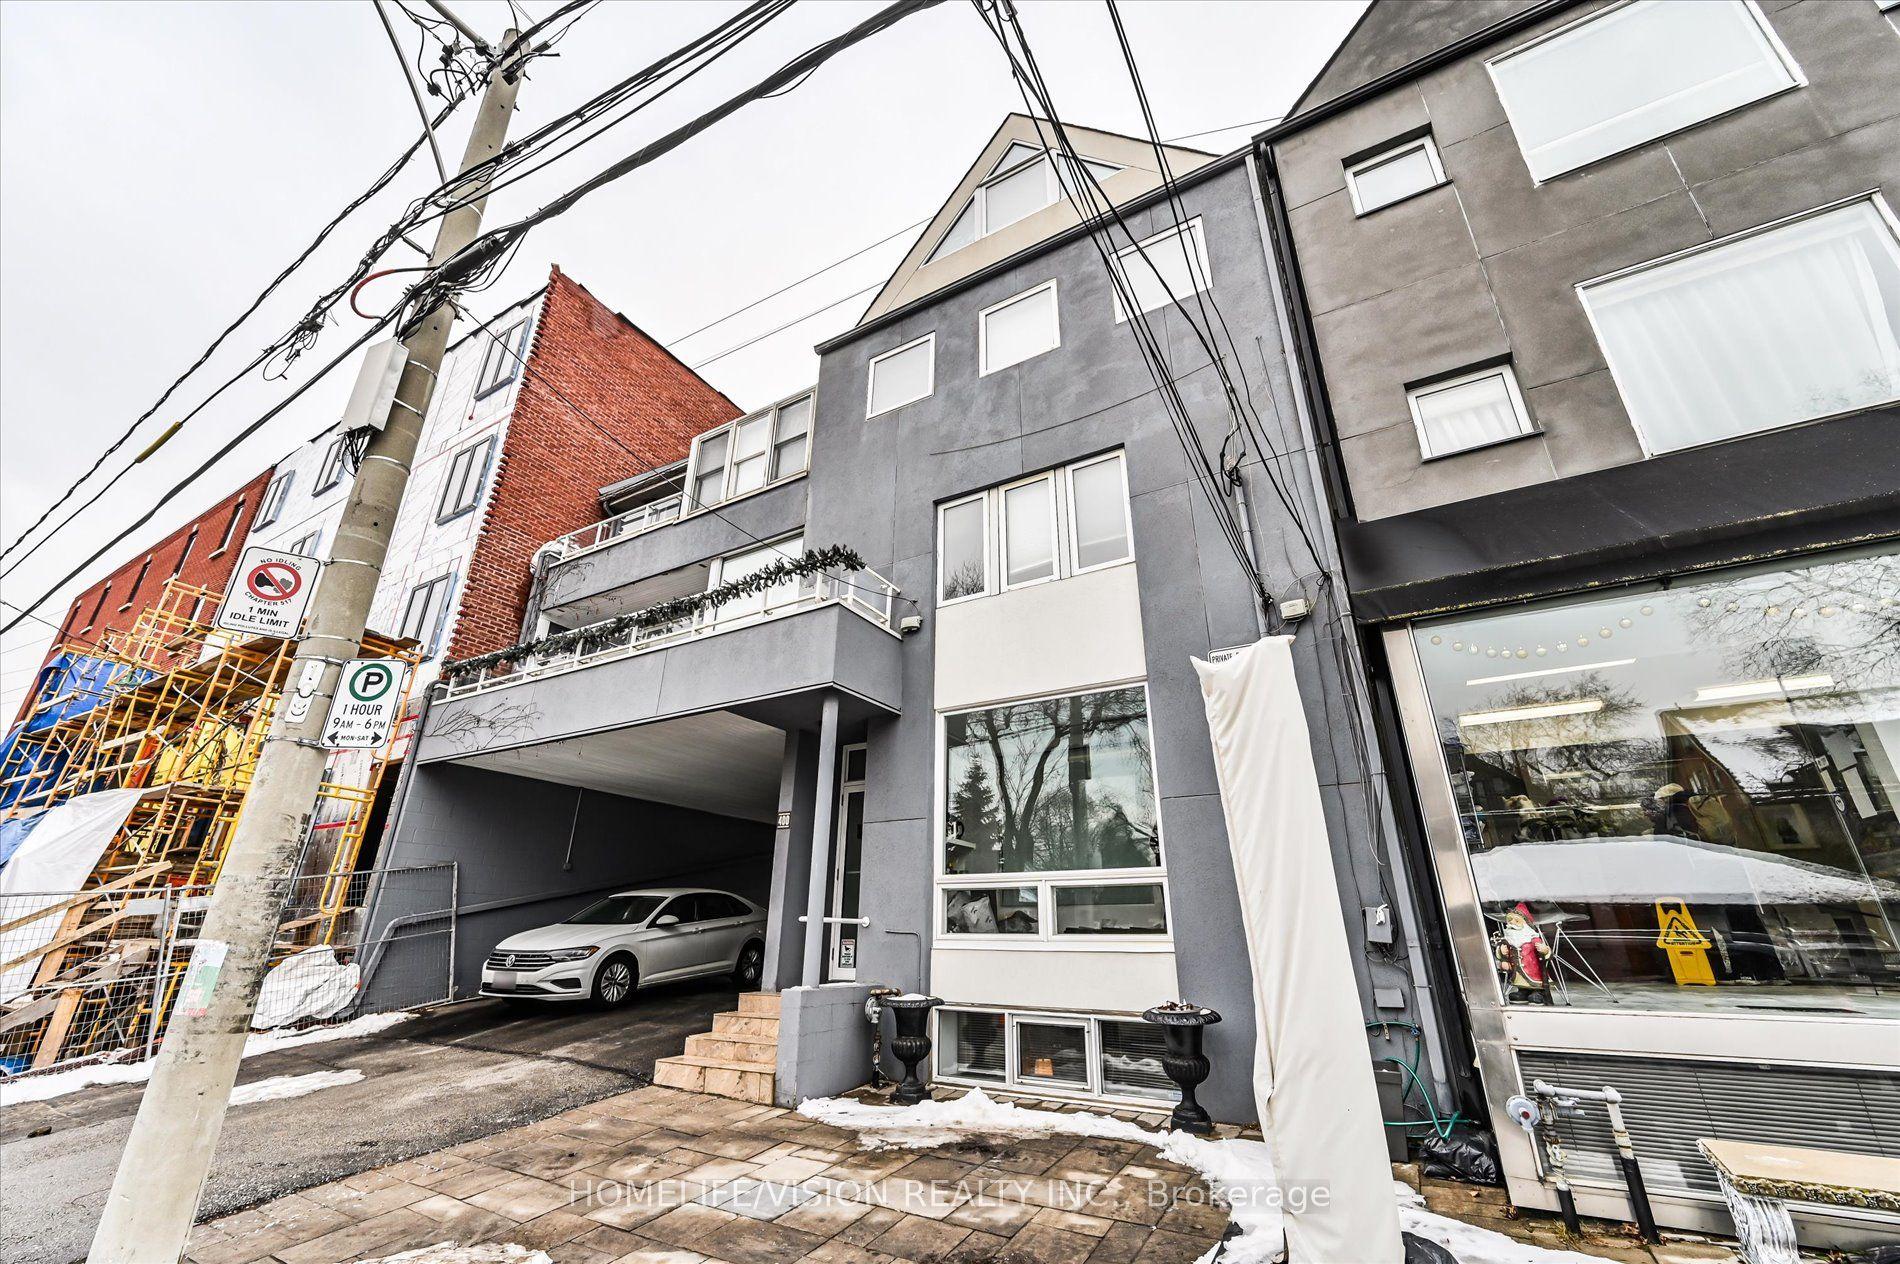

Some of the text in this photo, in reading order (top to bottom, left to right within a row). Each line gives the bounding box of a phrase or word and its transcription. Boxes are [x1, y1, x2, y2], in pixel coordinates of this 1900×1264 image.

[276, 558, 301, 571] IDLING
[245, 591, 292, 606] CHAPTER 517
[257, 607, 278, 617] MIN
[229, 612, 290, 628] IDLE LIMIT
[361, 672, 384, 693] P
[343, 704, 383, 716] 1 HOUR
